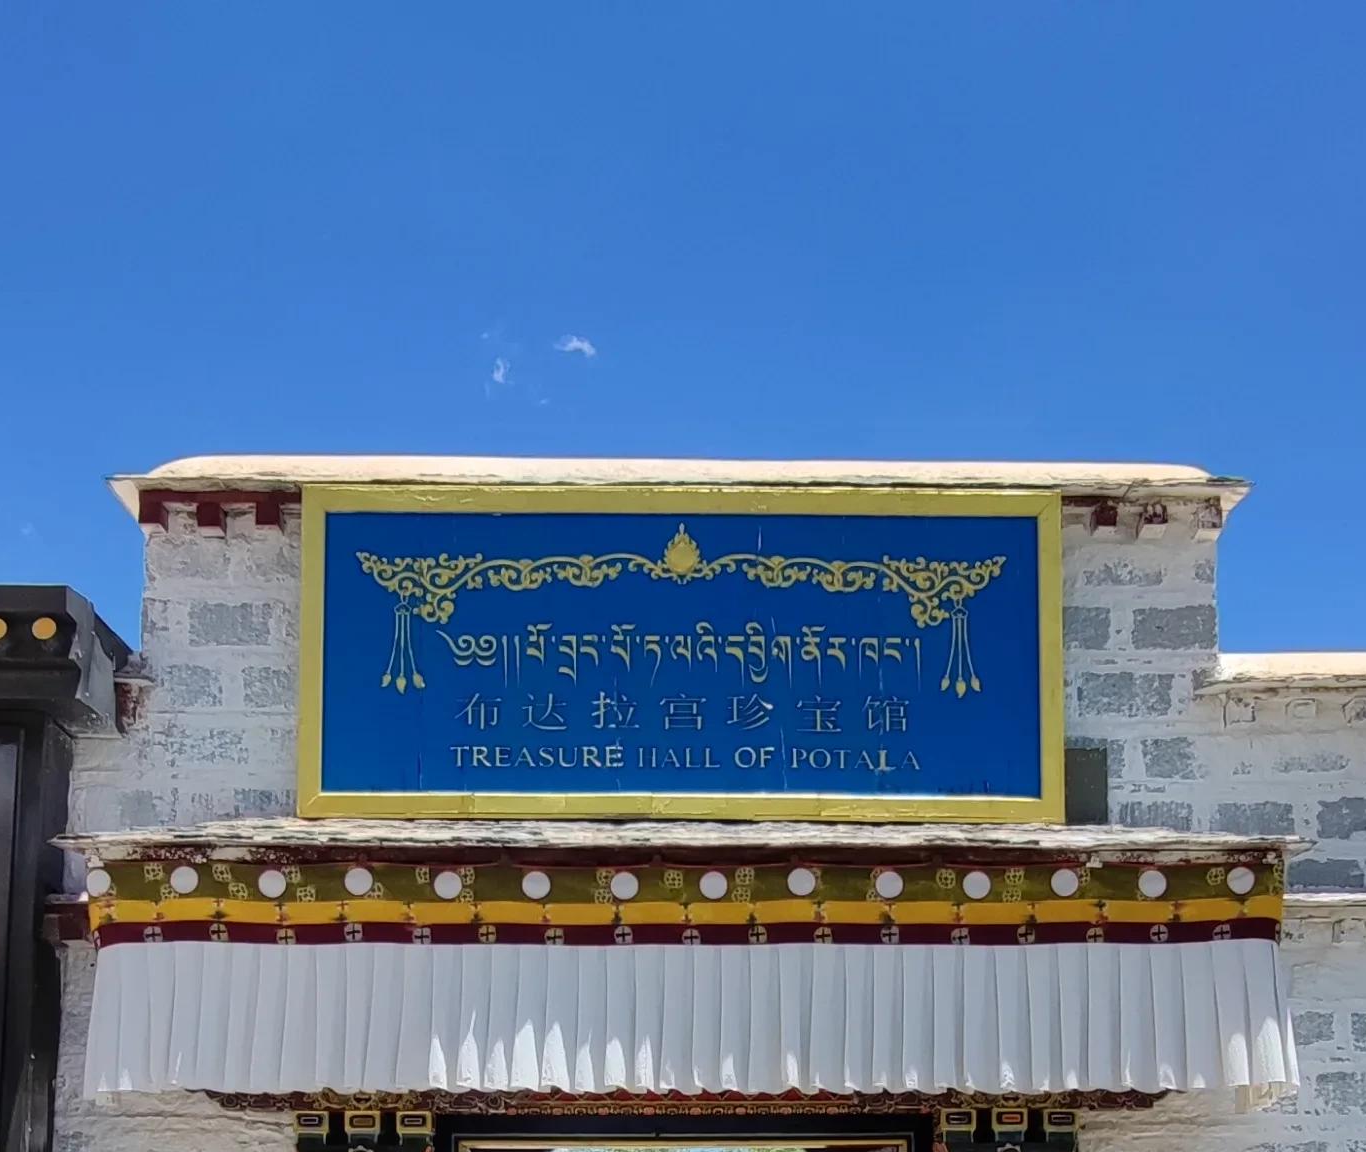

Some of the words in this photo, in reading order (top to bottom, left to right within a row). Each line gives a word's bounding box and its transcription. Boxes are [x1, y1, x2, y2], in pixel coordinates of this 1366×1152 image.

[454, 692, 911, 734] 布达拉宫珍宝馆
[450, 745, 625, 769] TREASURE
[638, 745, 720, 769] HALL
[734, 745, 776, 769] OF
[791, 746, 922, 772] POTALA
